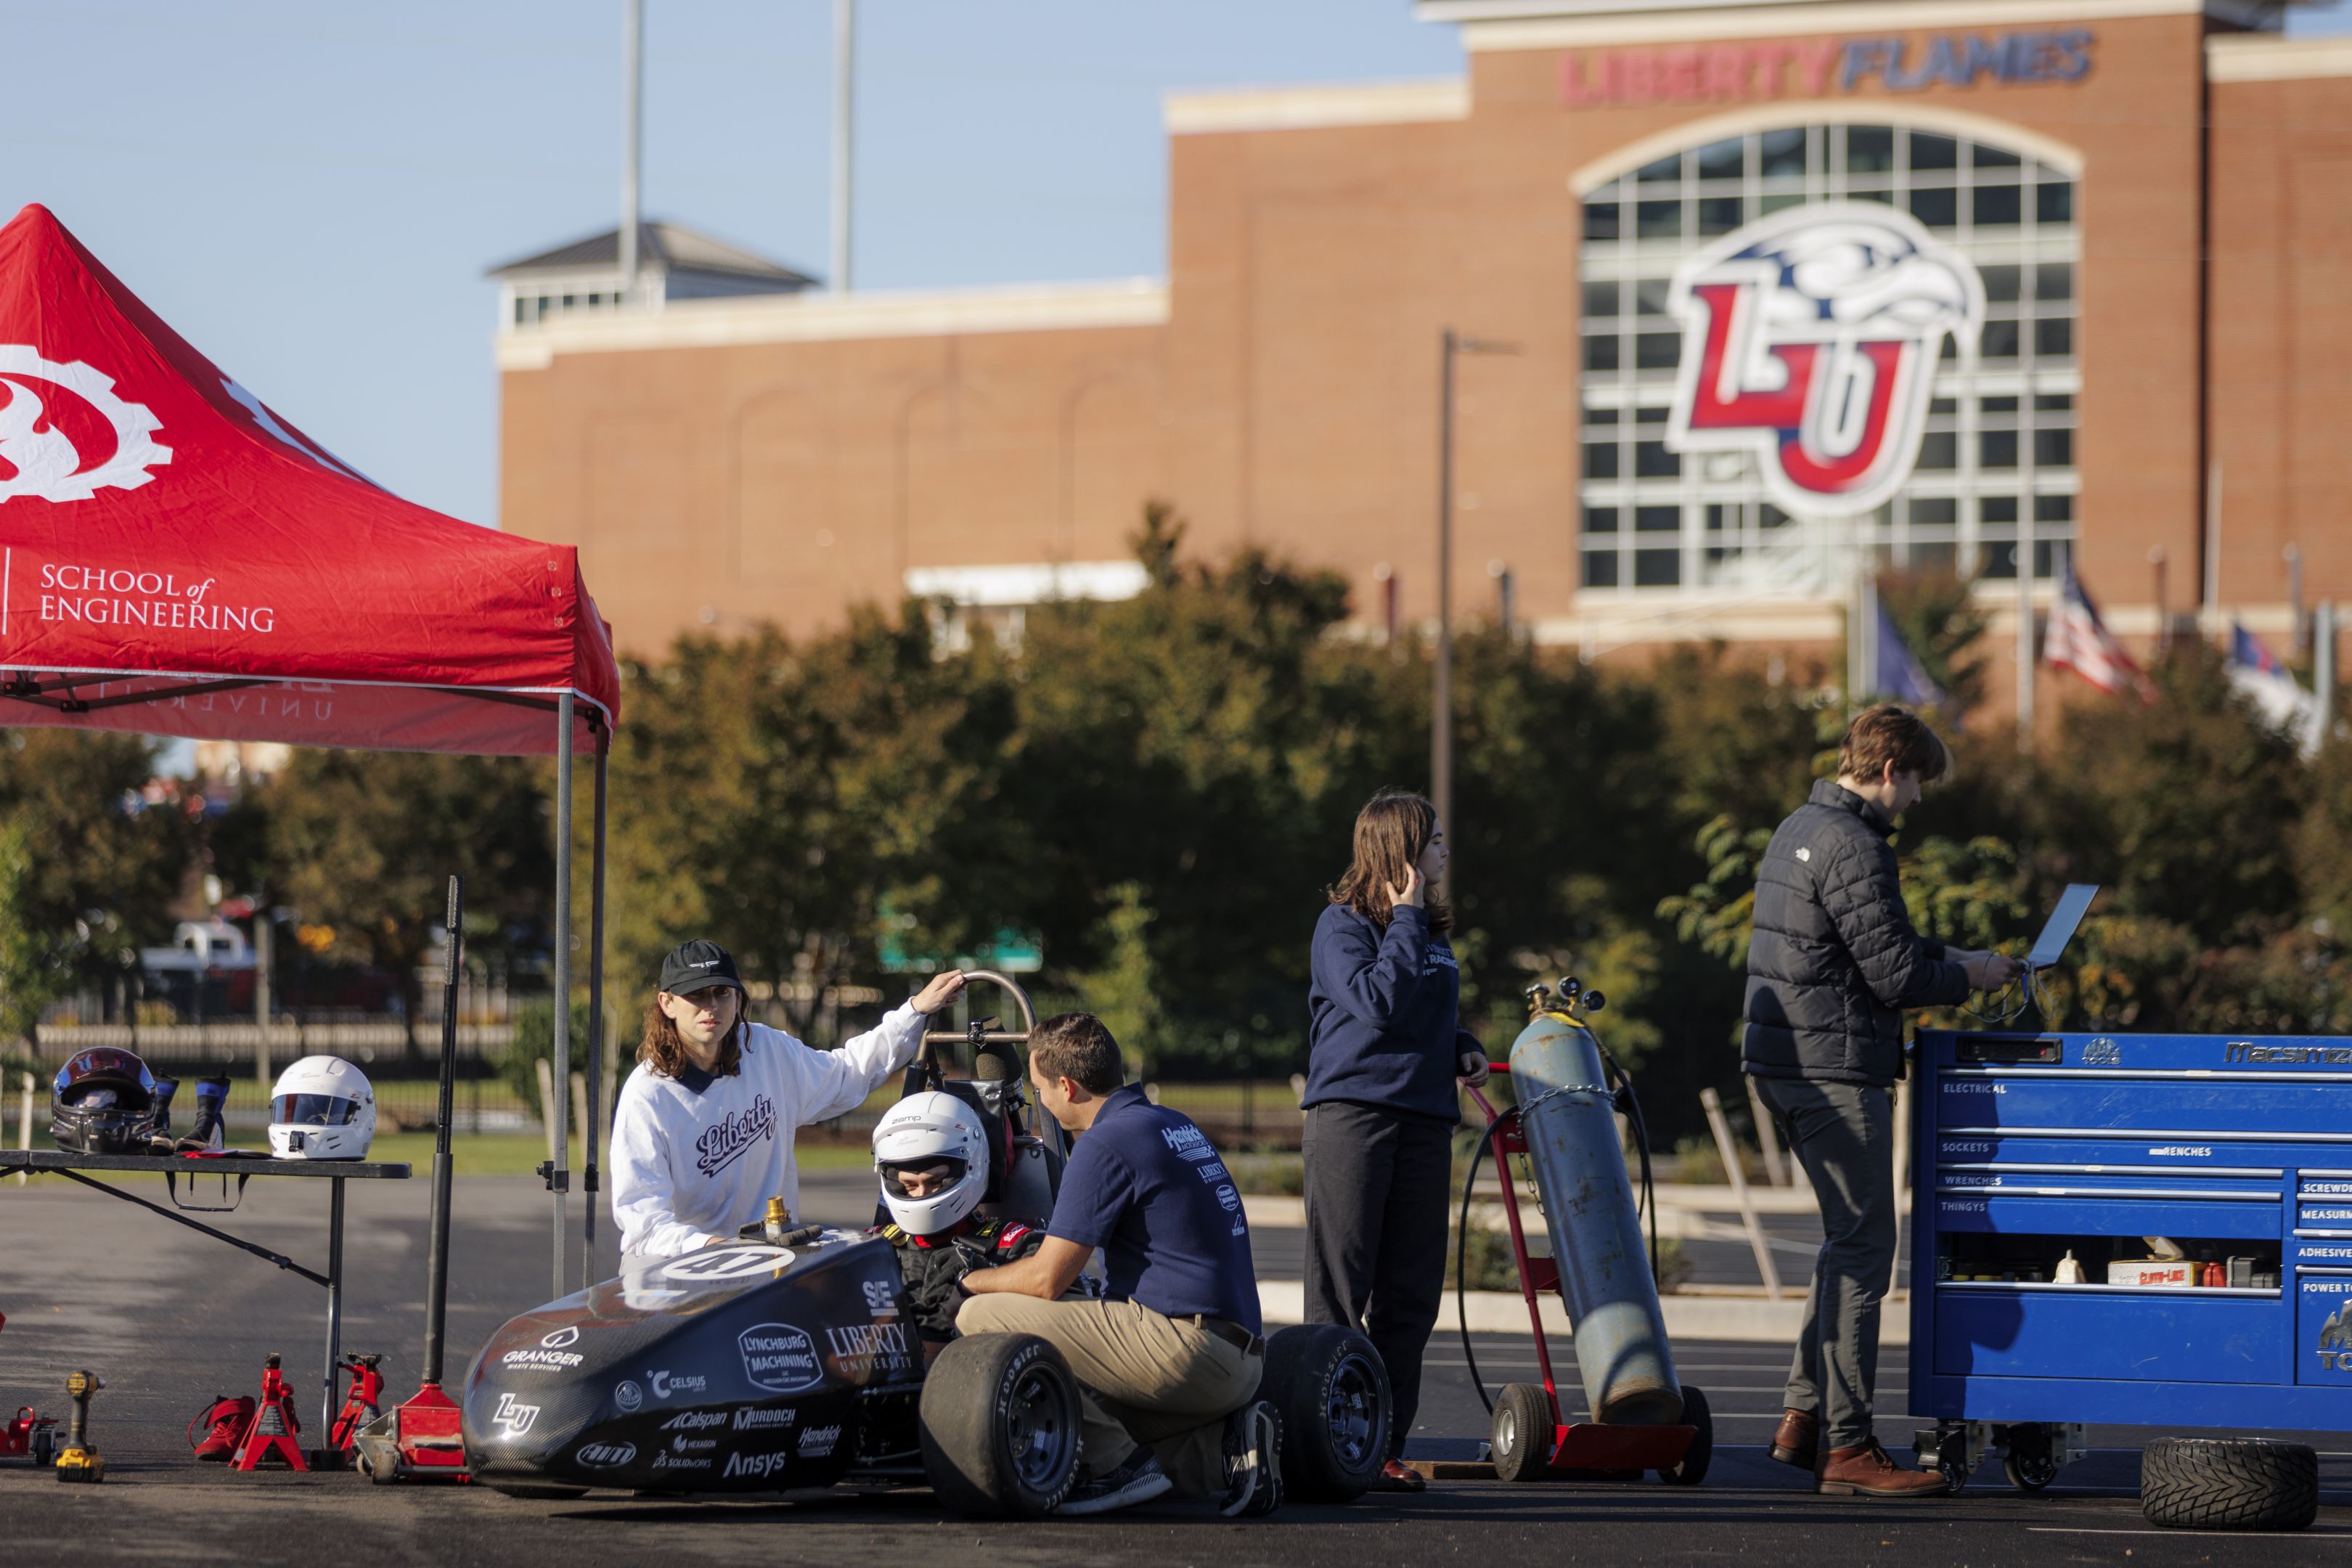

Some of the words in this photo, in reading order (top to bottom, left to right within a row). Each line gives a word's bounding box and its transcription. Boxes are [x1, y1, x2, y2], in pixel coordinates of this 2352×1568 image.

[1561, 39, 1839, 106] LIBERTY
[1839, 30, 2096, 92] FLAMES
[40, 563, 181, 597] SCHOOL
[187, 578, 215, 604] of
[40, 595, 274, 632] ENGINEERING
[2223, 1041, 2352, 1063] Macsimiz
[1943, 1083, 2007, 1094] ELECTRICAL
[891, 1114, 922, 1124] zamp
[696, 1093, 778, 1170] Liberty
[1942, 1143, 1989, 1152] SOCKETS
[2149, 1146, 2212, 1156] RENCHES
[1197, 1161, 1225, 1179] LIBERTY
[1945, 1176, 2003, 1186] WRENCHES
[1940, 1201, 1986, 1212] THINGYS
[2298, 1247, 2352, 1257] ADHESIVE
[672, 1251, 786, 1275] 47
[862, 1281, 895, 1308] SAE
[2303, 1283, 2343, 1293] POWER
[743, 1334, 807, 1351] LYNCHBURG
[825, 1323, 909, 1358] LIBERTY
[502, 1350, 584, 1367] GRANGER
[751, 1353, 814, 1372] MACHINING
[839, 1356, 912, 1373] UNIVERSITY
[529, 1363, 563, 1372] SERVICES
[669, 1376, 706, 1389] CELSIUS
[492, 1392, 541, 1434] LU
[679, 1411, 728, 1430] Calspan
[732, 1408, 796, 1430] MURDOCH
[799, 1424, 841, 1447] Hendrick
[687, 1440, 716, 1449] HEXAGON
[668, 1458, 712, 1469] SOLIDWORKS
[723, 1451, 786, 1478] Ansys
